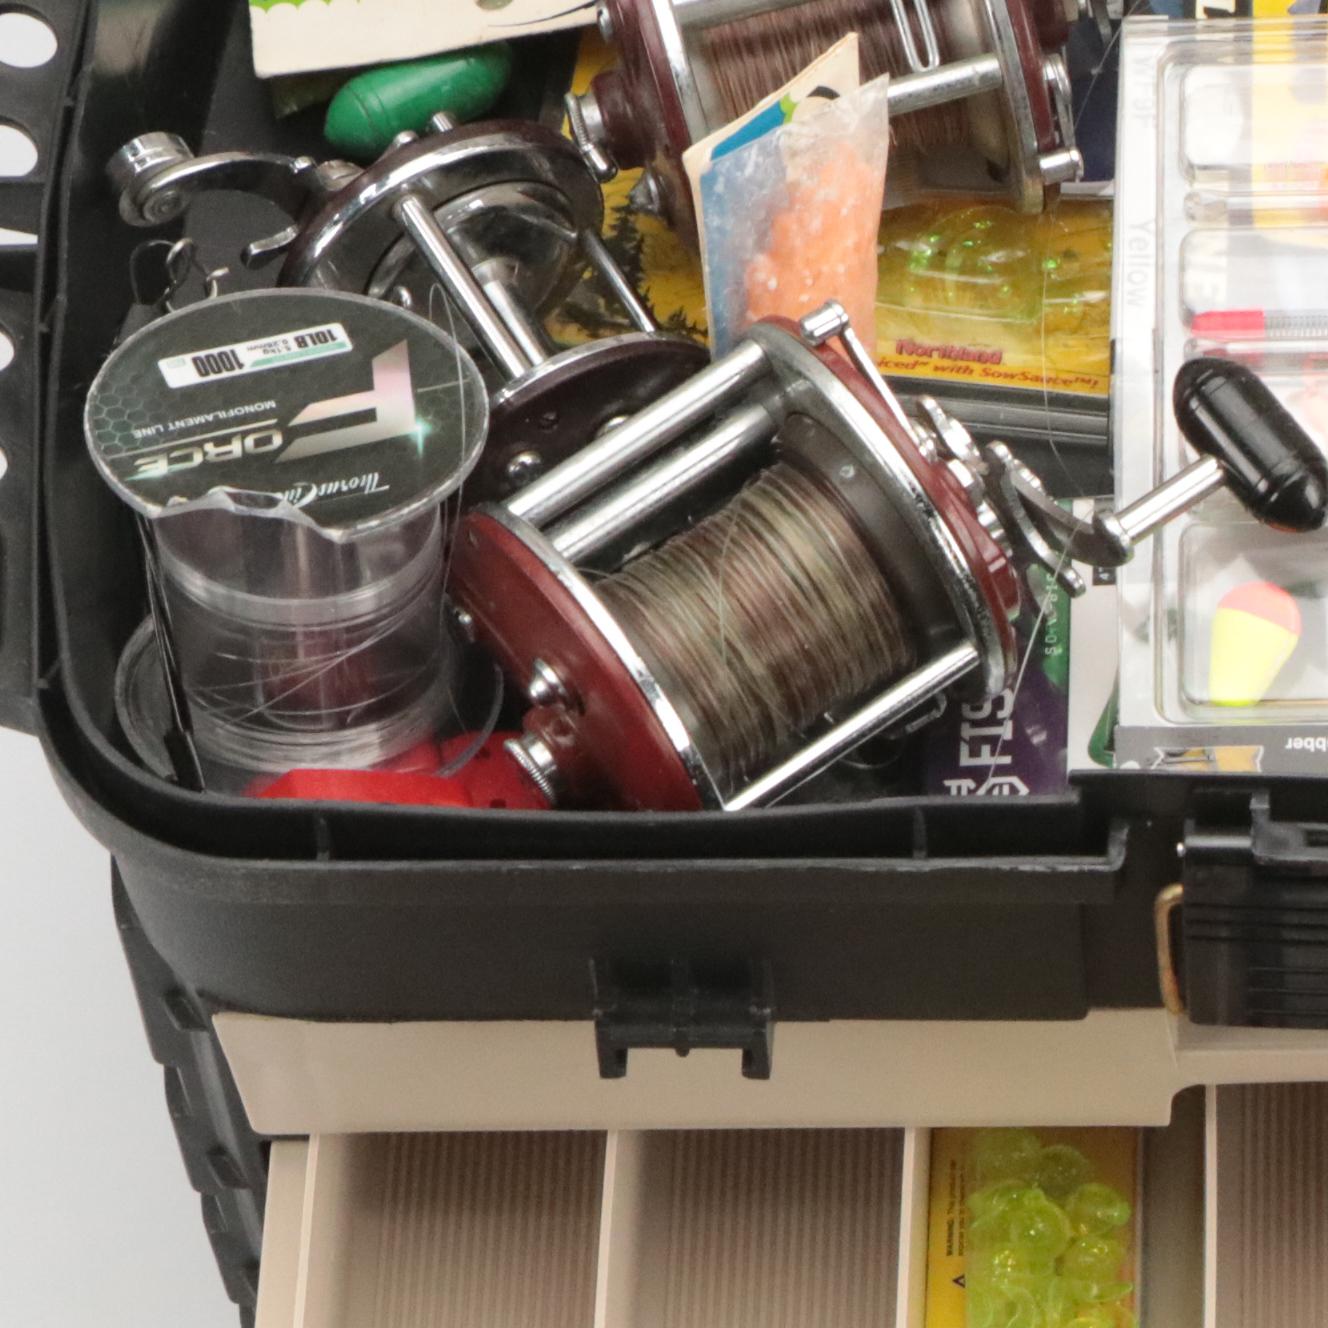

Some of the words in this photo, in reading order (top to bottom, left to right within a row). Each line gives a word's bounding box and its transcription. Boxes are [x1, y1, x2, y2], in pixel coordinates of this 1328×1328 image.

[1127, 218, 1155, 308] Yellow
[294, 328, 337, 348] 10LB
[895, 338, 1003, 365] Northland
[191, 349, 245, 378] 1000
[932, 363, 974, 376] with
[133, 421, 165, 439] LINE
[168, 400, 277, 434] MONOFILAMENT
